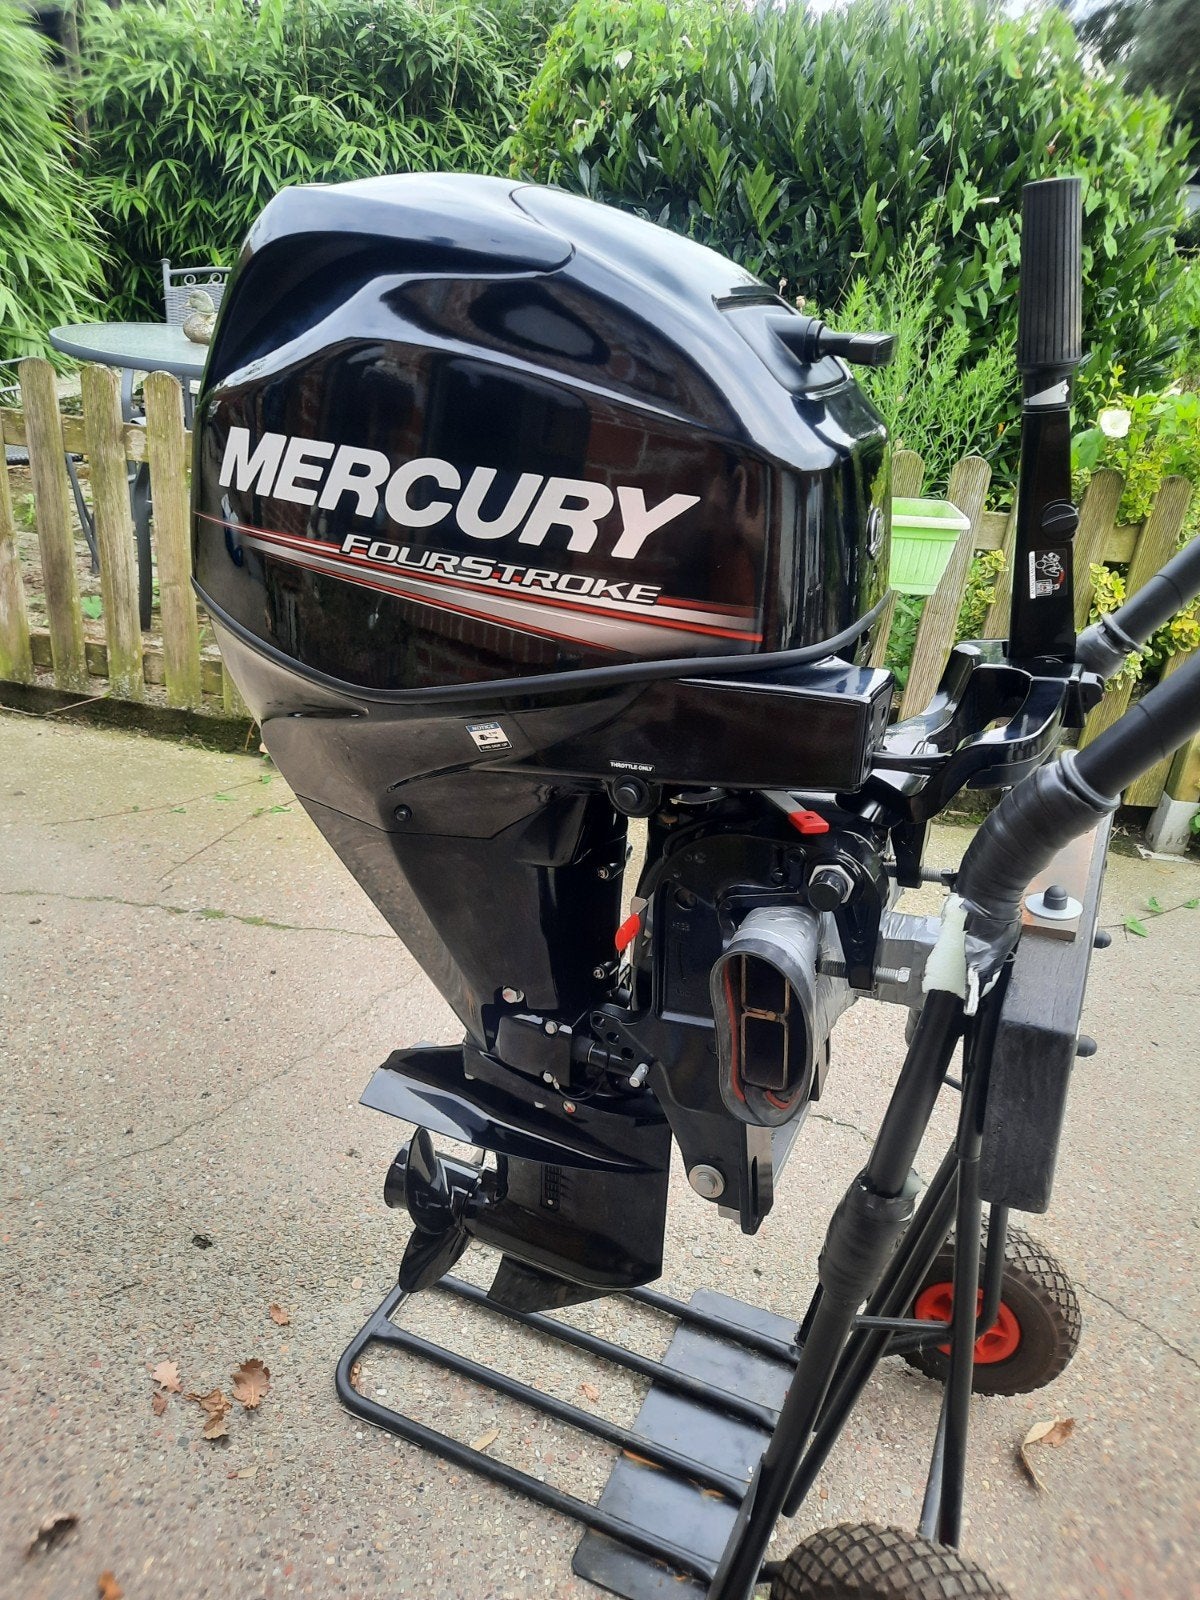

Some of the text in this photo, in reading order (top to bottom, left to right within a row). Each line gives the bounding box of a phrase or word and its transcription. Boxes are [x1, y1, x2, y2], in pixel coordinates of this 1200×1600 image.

[219, 426, 701, 560] MERCURY
[339, 534, 663, 604] FOURSTROKE
[610, 762, 637, 770] THROTTLE
